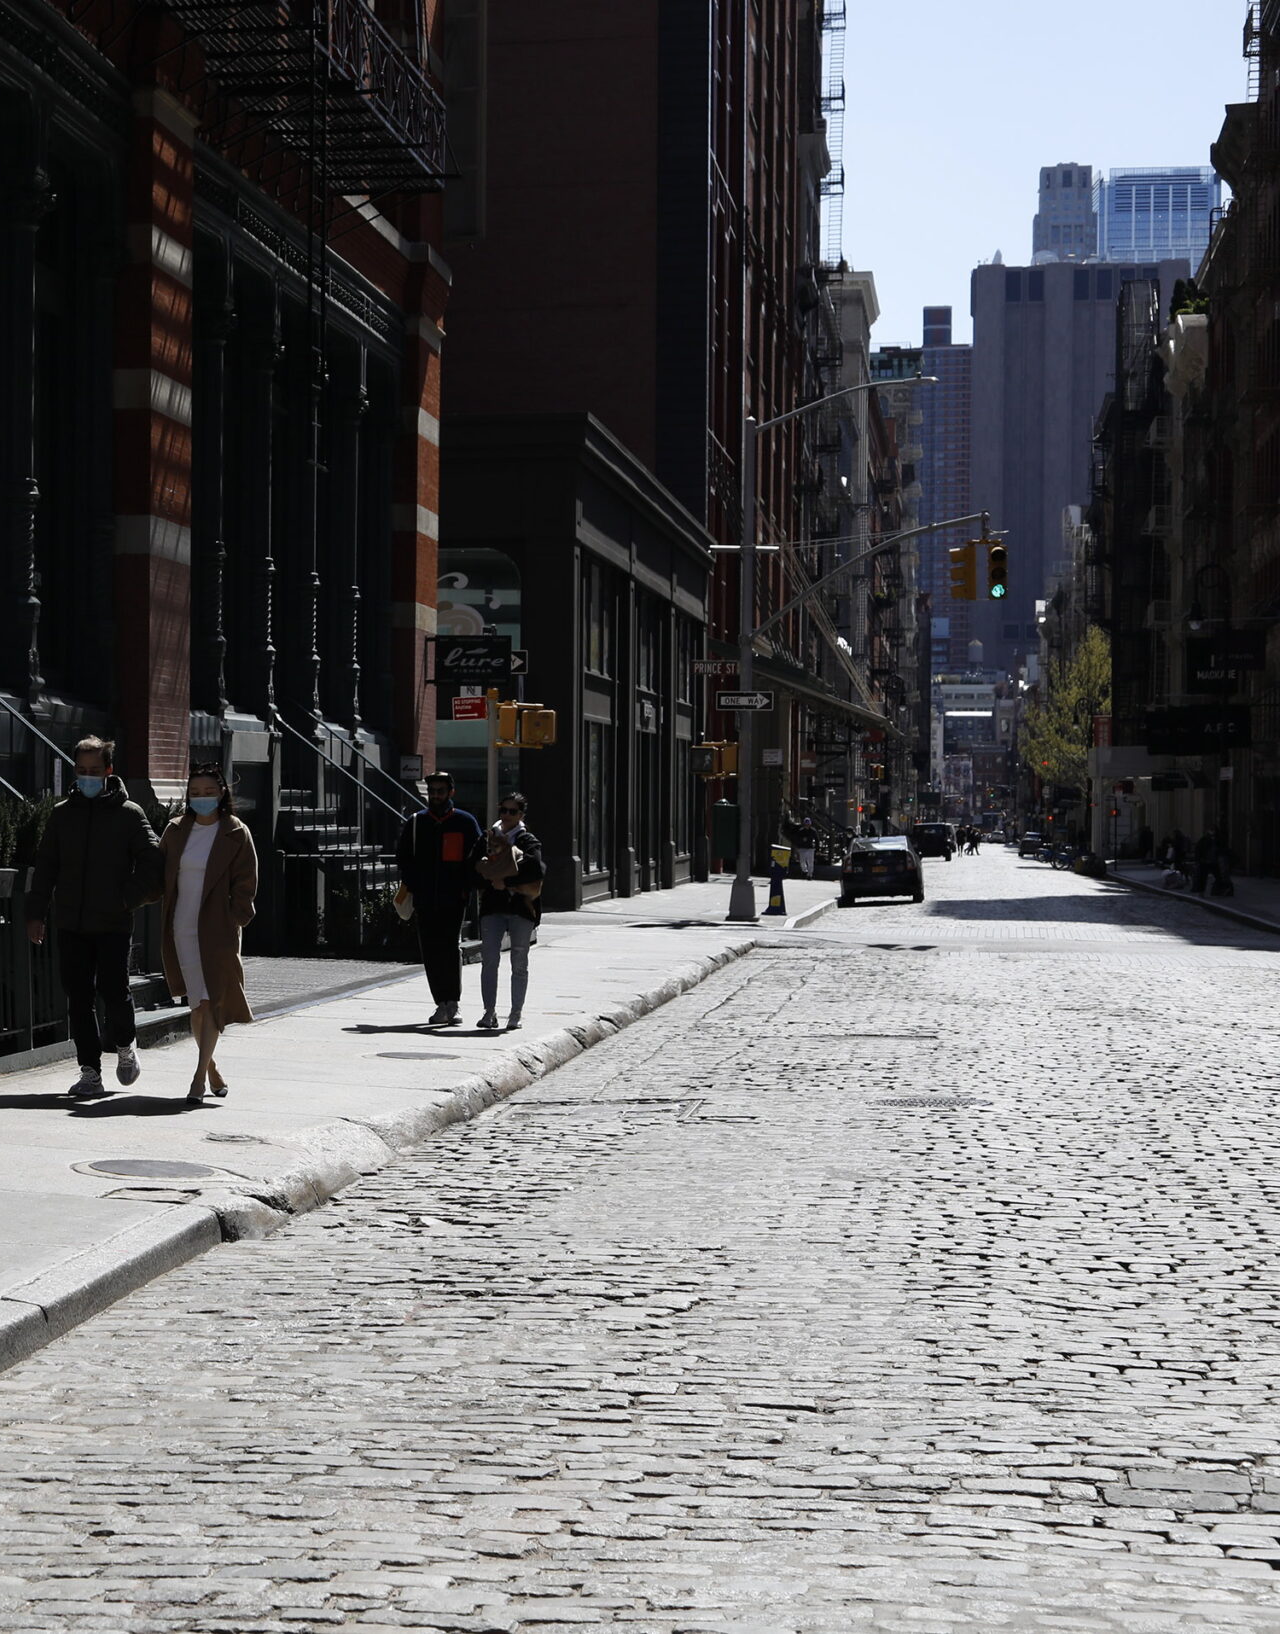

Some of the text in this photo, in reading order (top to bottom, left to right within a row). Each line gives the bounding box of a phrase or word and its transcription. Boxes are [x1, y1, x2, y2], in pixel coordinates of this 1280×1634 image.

[694, 662, 736, 674] PRINCE ST
[724, 697, 765, 705] ONE WAY
